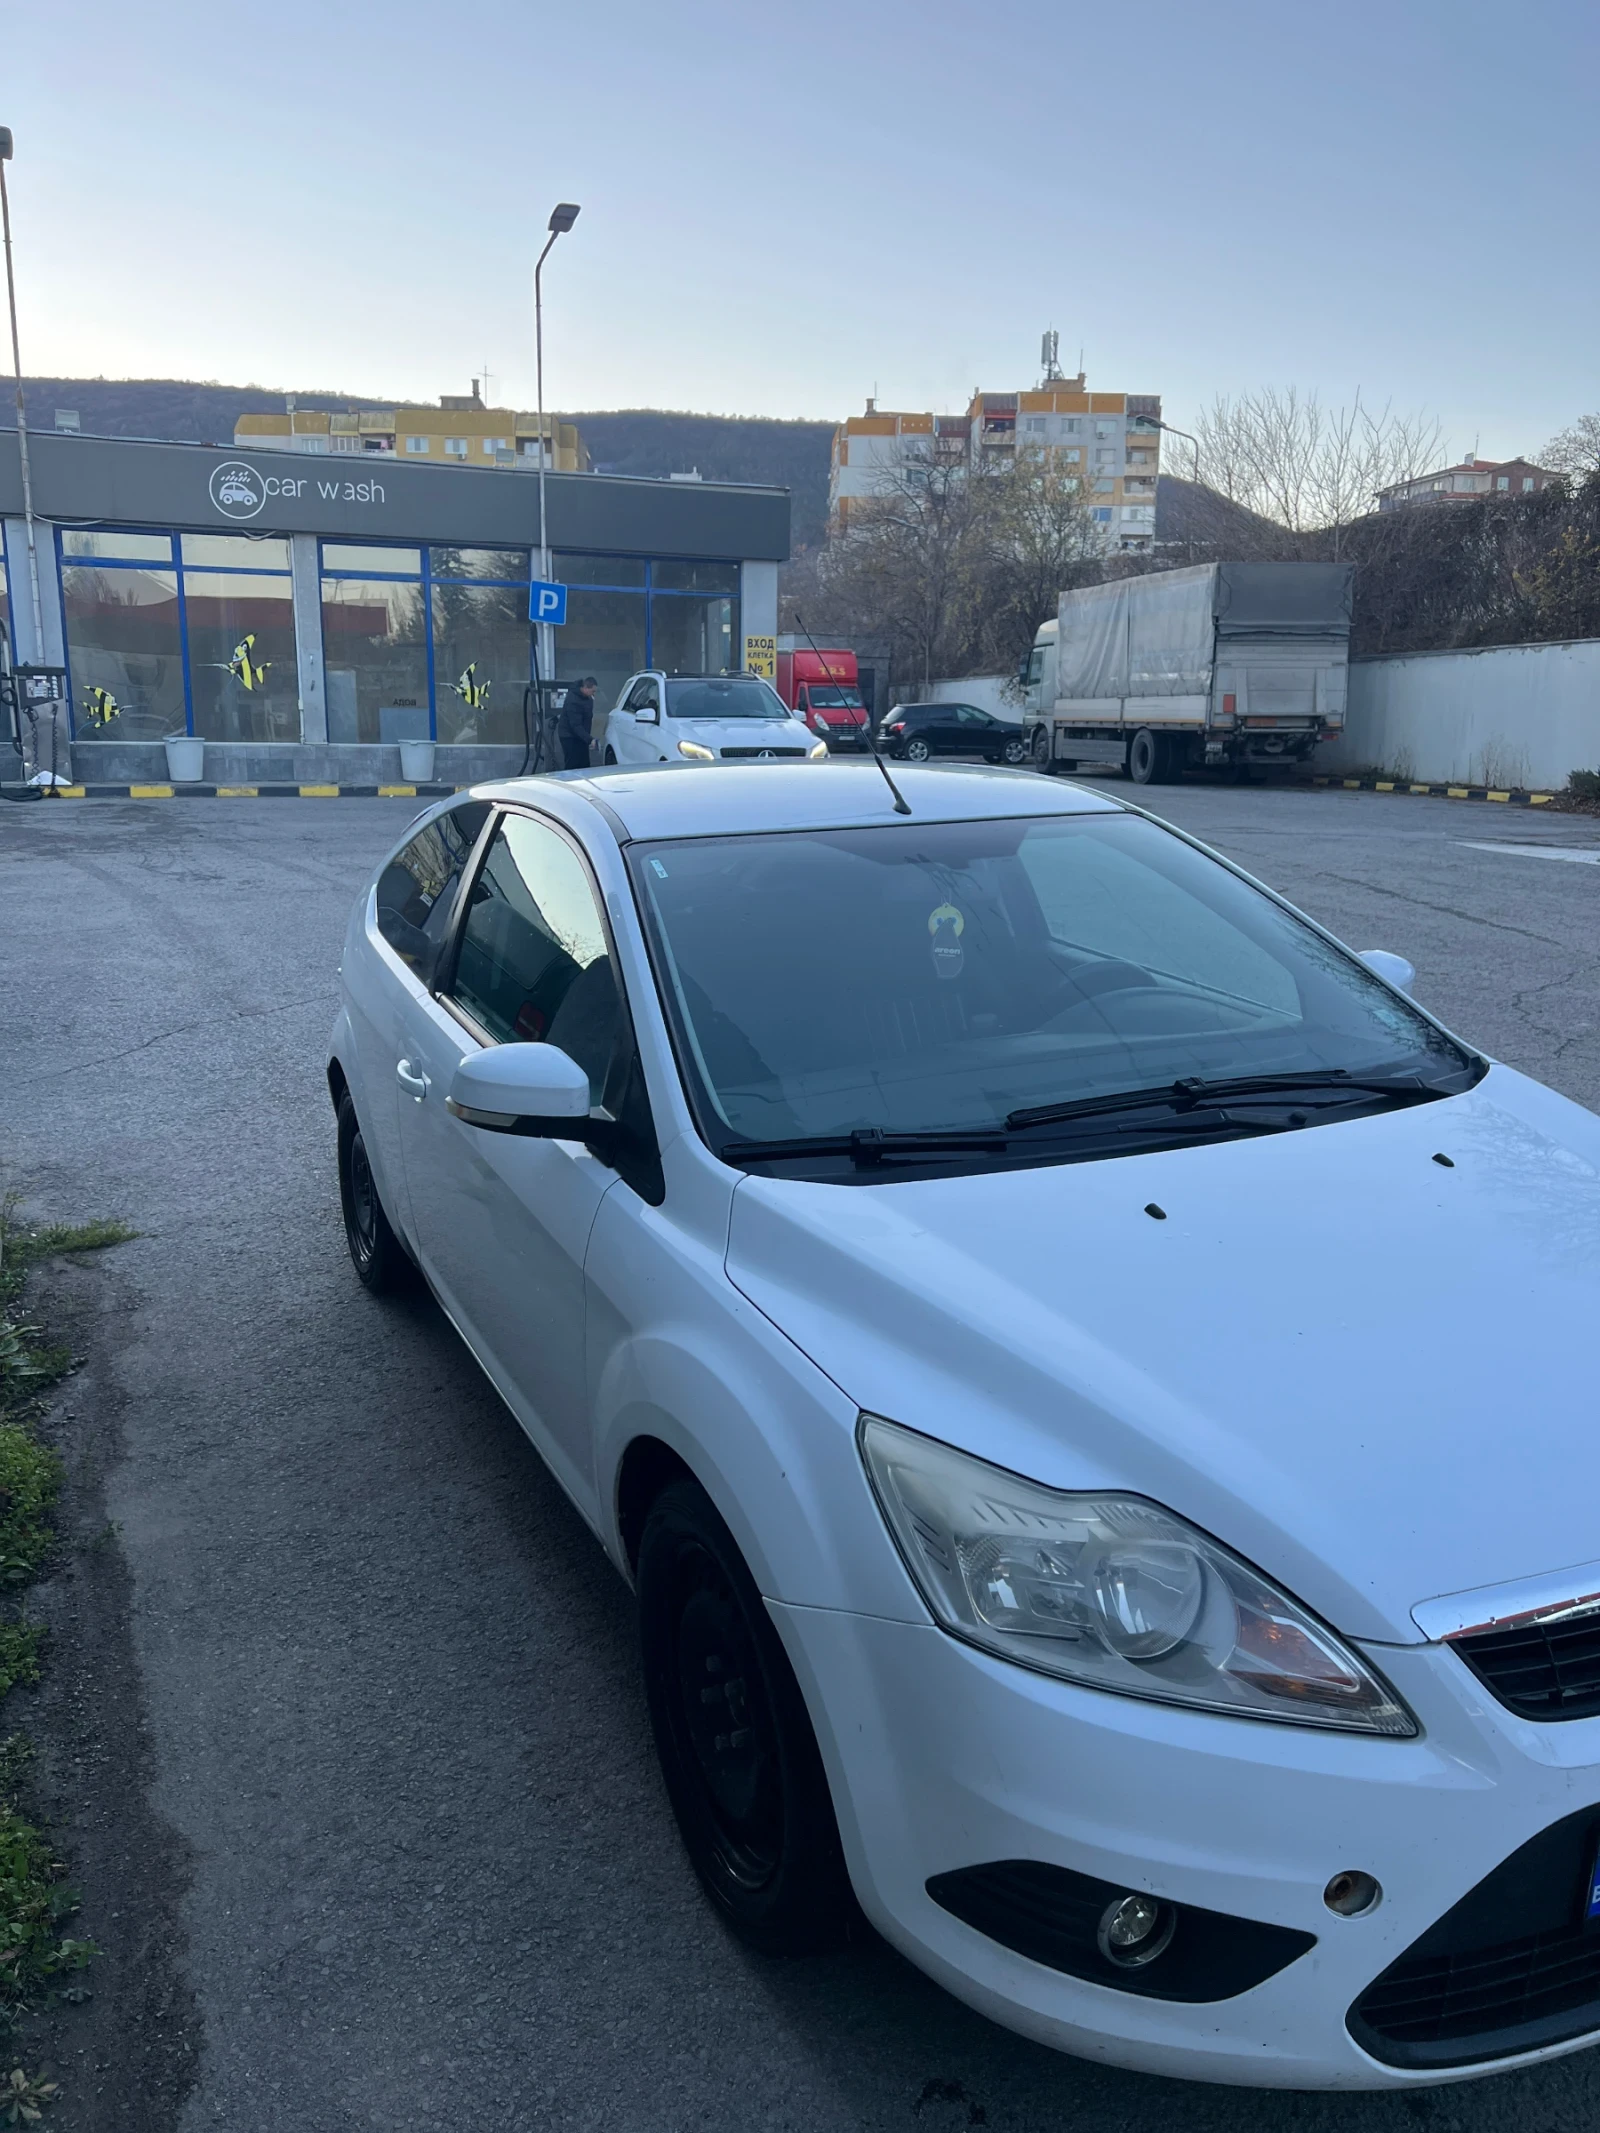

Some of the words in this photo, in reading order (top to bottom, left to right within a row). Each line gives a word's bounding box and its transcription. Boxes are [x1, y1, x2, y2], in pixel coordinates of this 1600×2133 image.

[265, 477, 308, 498] car
[317, 479, 385, 503] wash
[538, 589, 559, 617] P
[747, 638, 774, 650] ВХОД
[767, 660, 773, 675] 1
